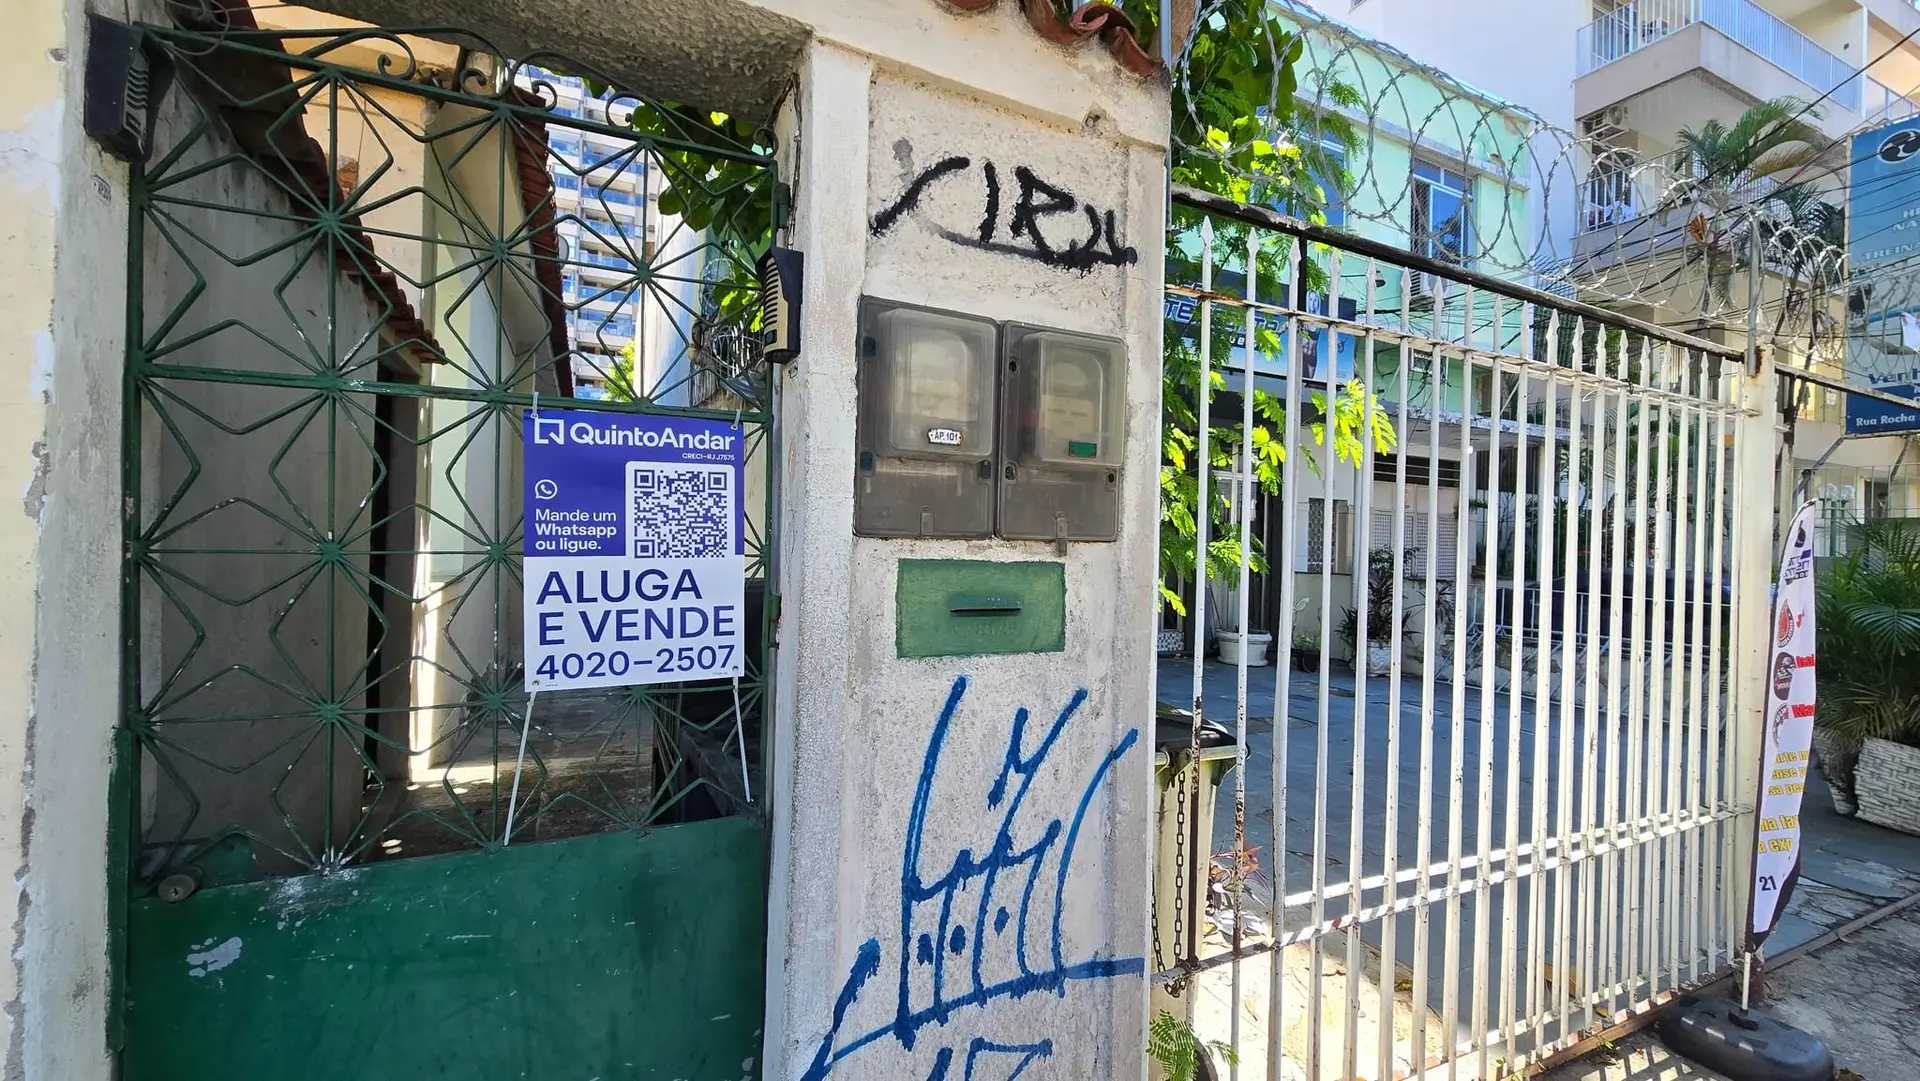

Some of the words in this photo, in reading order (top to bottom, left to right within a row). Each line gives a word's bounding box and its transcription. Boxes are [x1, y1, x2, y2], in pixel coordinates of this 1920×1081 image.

[1856, 417, 1877, 427] Rua
[1881, 413, 1916, 425] Rocha
[569, 421, 736, 451] QuintoAndar
[535, 508, 589, 523] Mande
[593, 510, 617, 522] um
[535, 523, 618, 542] Whatsapp
[535, 539, 556, 551] ou
[559, 537, 602, 553] ligue.
[536, 568, 703, 605] ALUGA
[538, 611, 565, 646] E
[578, 605, 736, 643] VENDE
[536, 644, 736, 681] 4020-2507
[1759, 875, 1777, 891] 21
